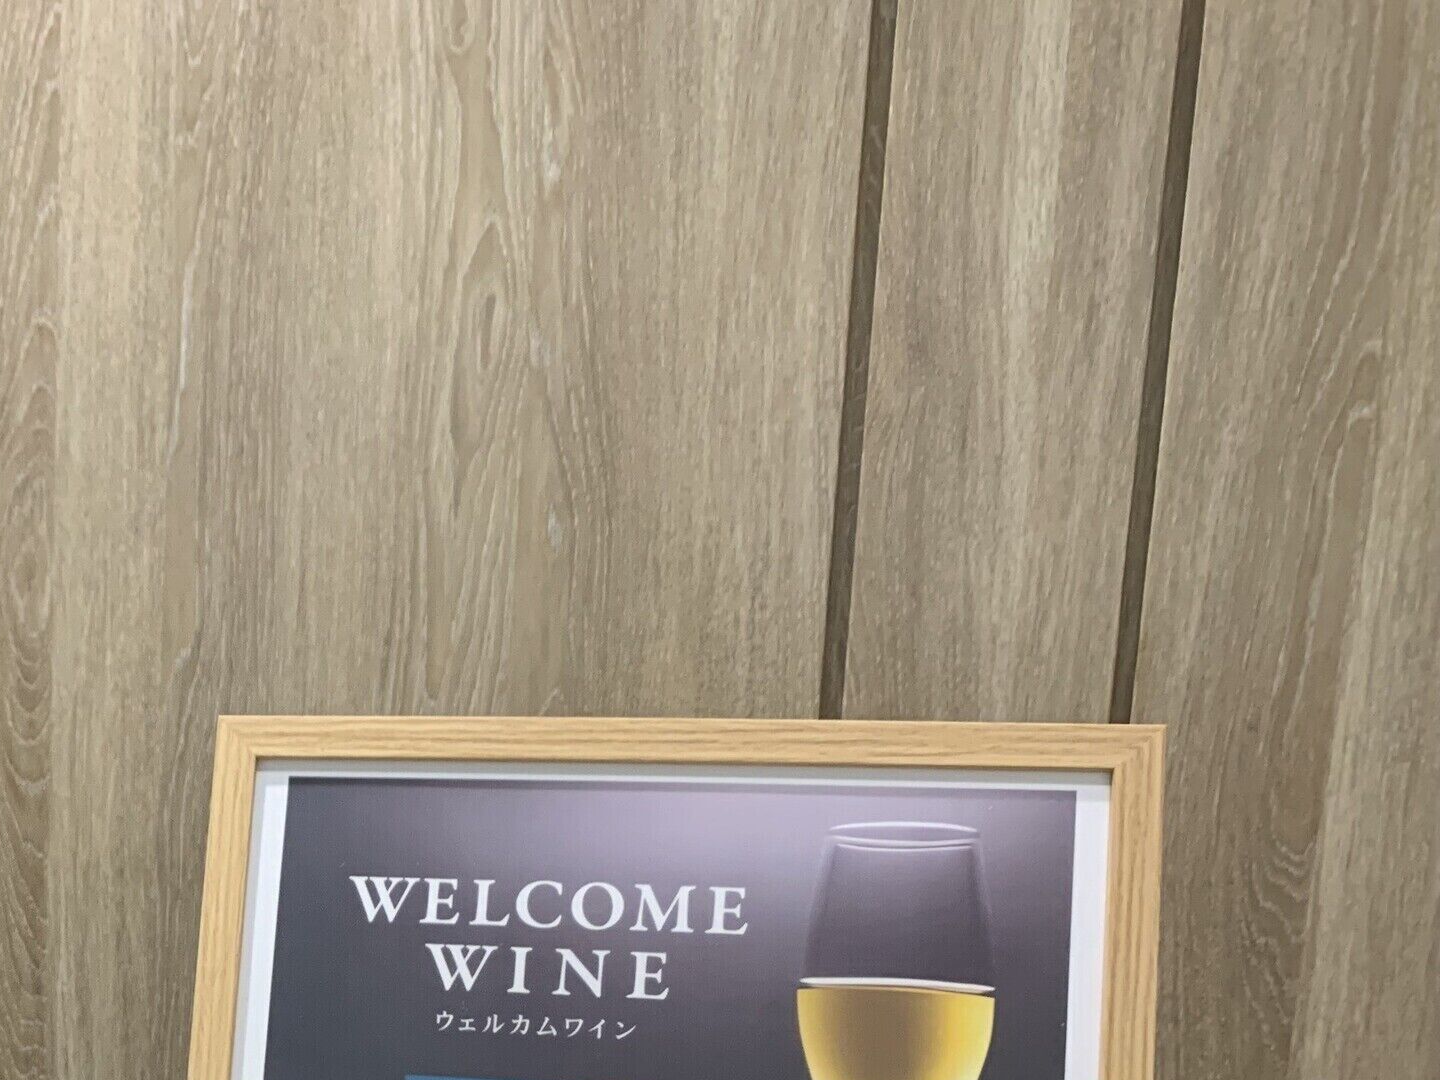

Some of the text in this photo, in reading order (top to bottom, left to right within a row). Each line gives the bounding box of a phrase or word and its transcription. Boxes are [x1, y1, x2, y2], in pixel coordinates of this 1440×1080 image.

[349, 875, 749, 936] WELCOME
[425, 942, 670, 1001] WINE
[435, 1010, 637, 1040] ウェルカムワイン
